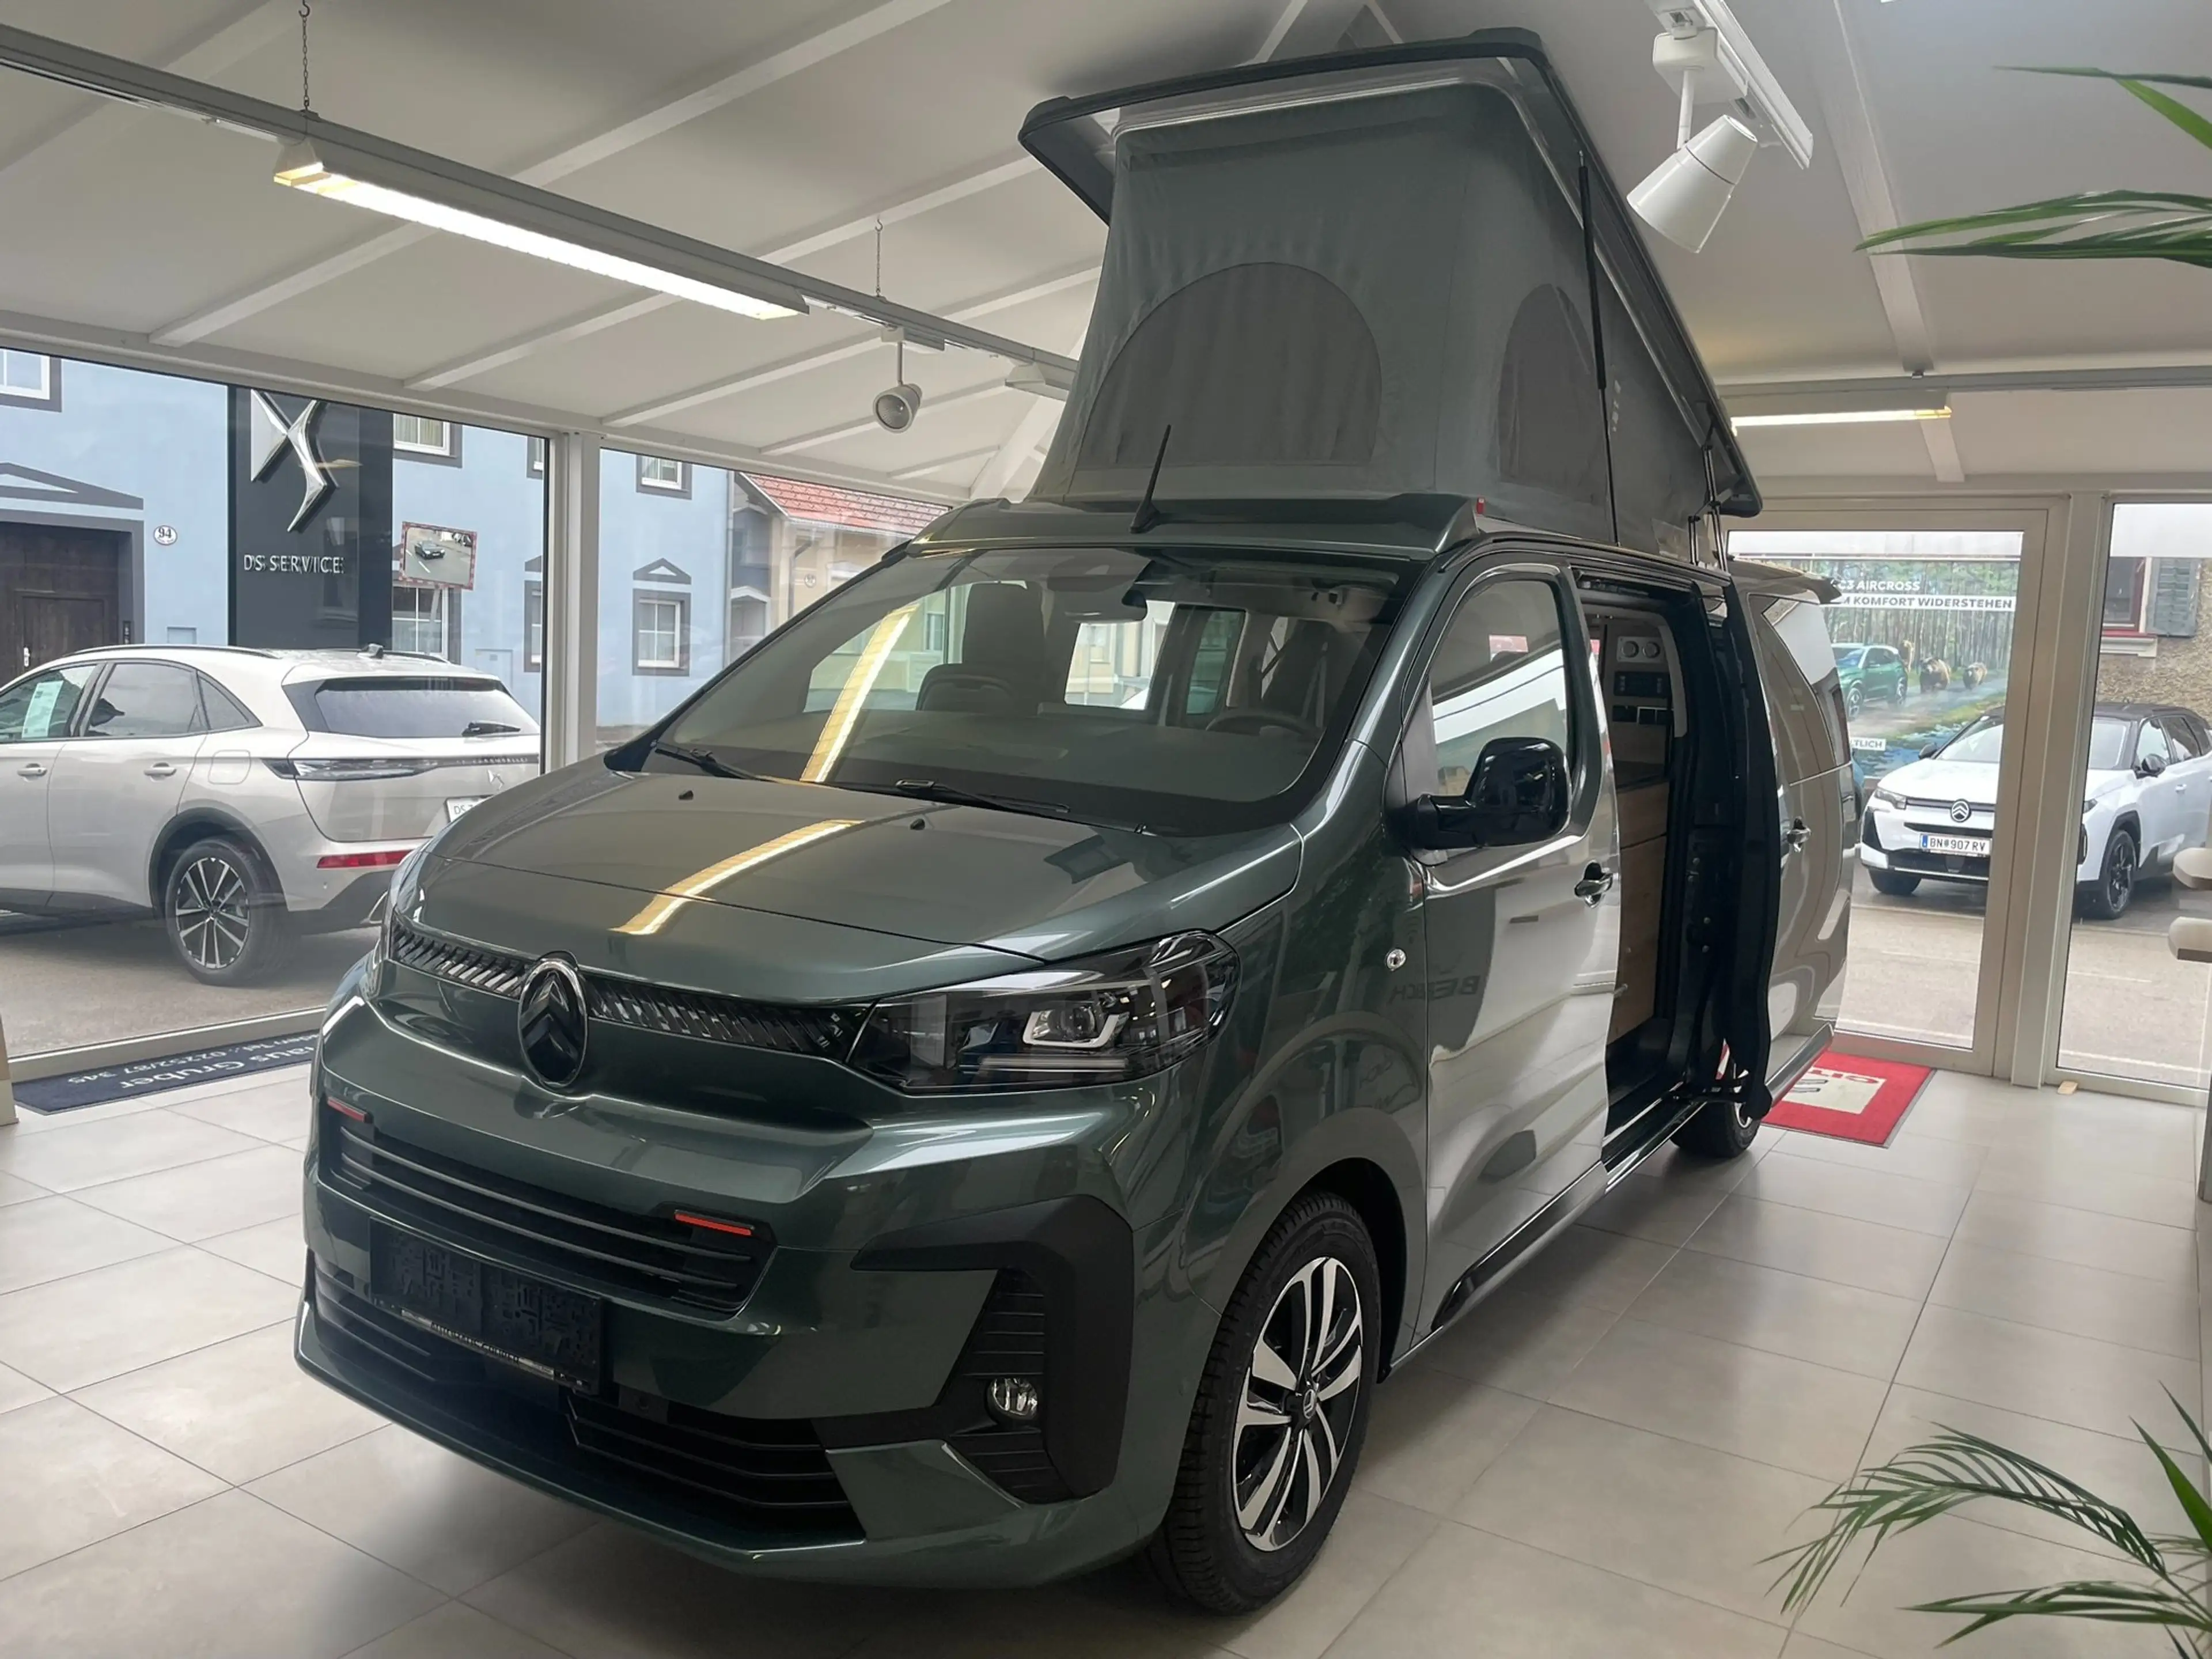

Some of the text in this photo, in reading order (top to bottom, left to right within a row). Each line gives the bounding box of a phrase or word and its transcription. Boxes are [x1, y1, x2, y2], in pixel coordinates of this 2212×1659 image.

[158, 527, 172, 538] 94
[244, 555, 342, 574] DS SERVICE
[1856, 580, 1921, 591] AIRCROSS
[1853, 596, 1915, 606] KOMFORT
[1918, 597, 2012, 609] WIDERSTEHEN
[1850, 740, 1883, 748] TLICH
[1930, 838, 1986, 851] BN 907 RV
[119, 1061, 245, 1089] Gruber
